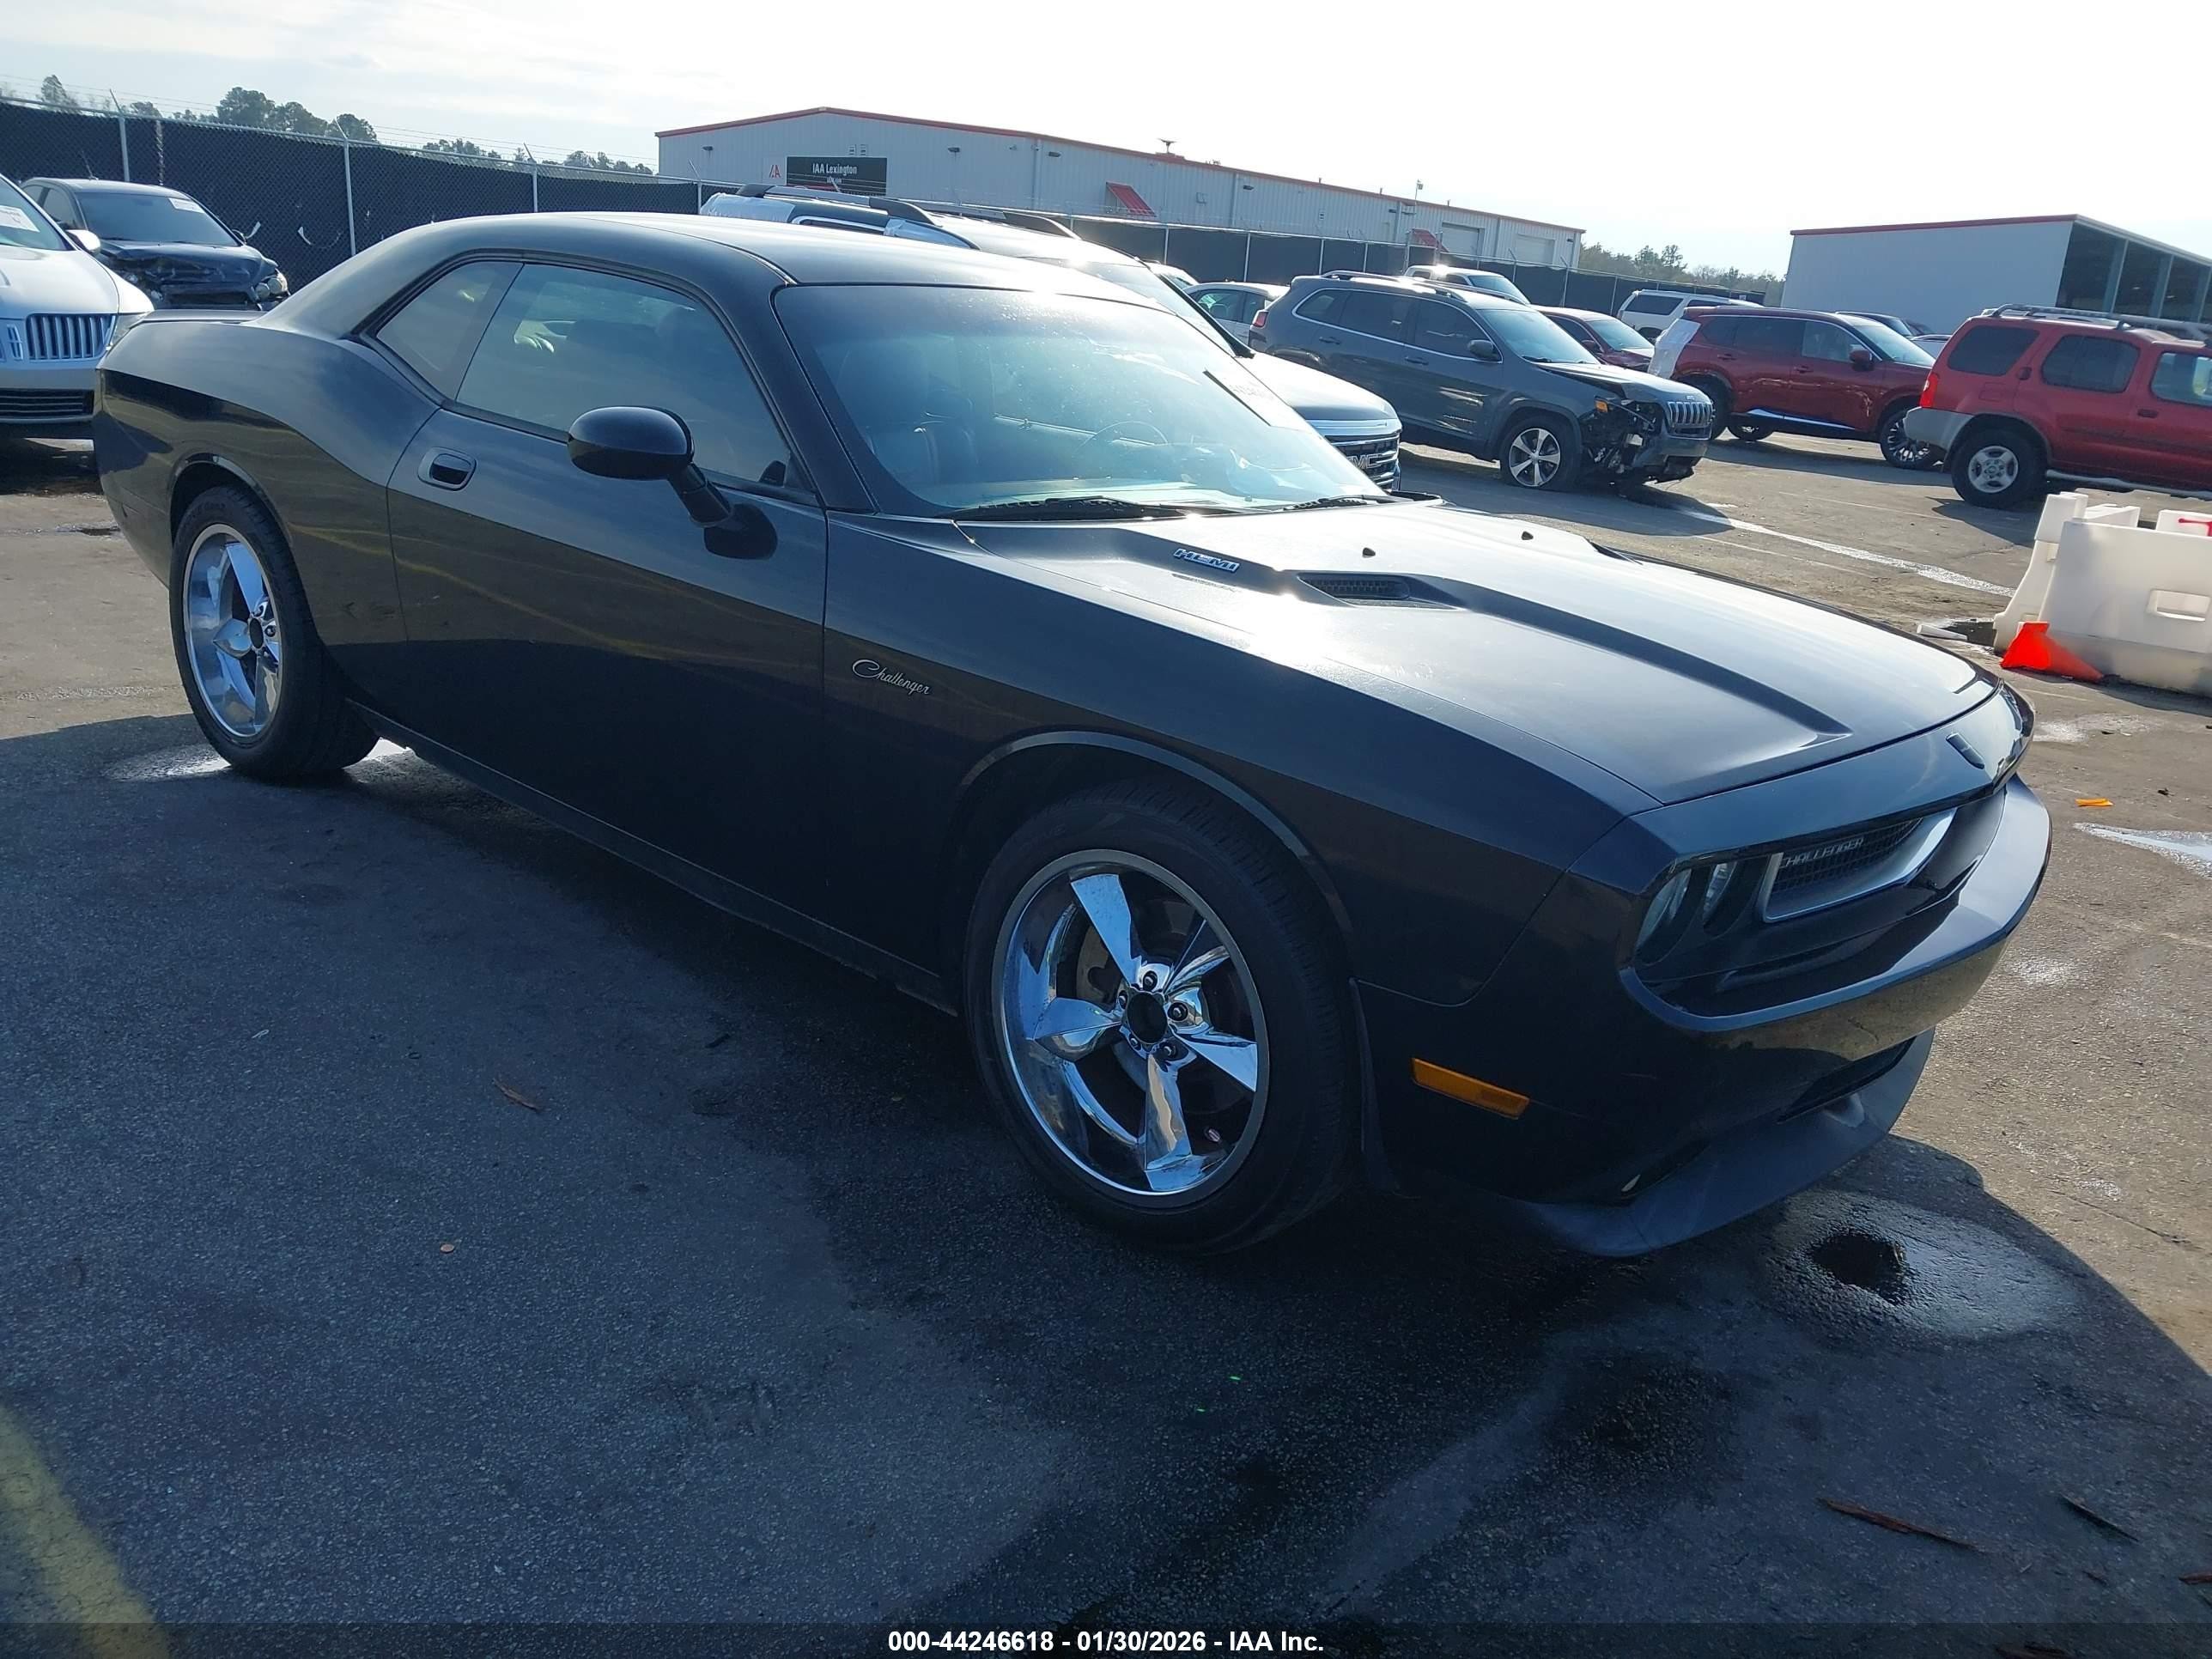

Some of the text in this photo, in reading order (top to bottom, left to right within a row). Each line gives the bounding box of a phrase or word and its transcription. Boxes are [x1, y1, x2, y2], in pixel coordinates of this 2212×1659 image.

[812, 163, 858, 176] IAA Lexington
[1172, 548, 1240, 573] HEMI
[852, 659, 930, 696] Challenger
